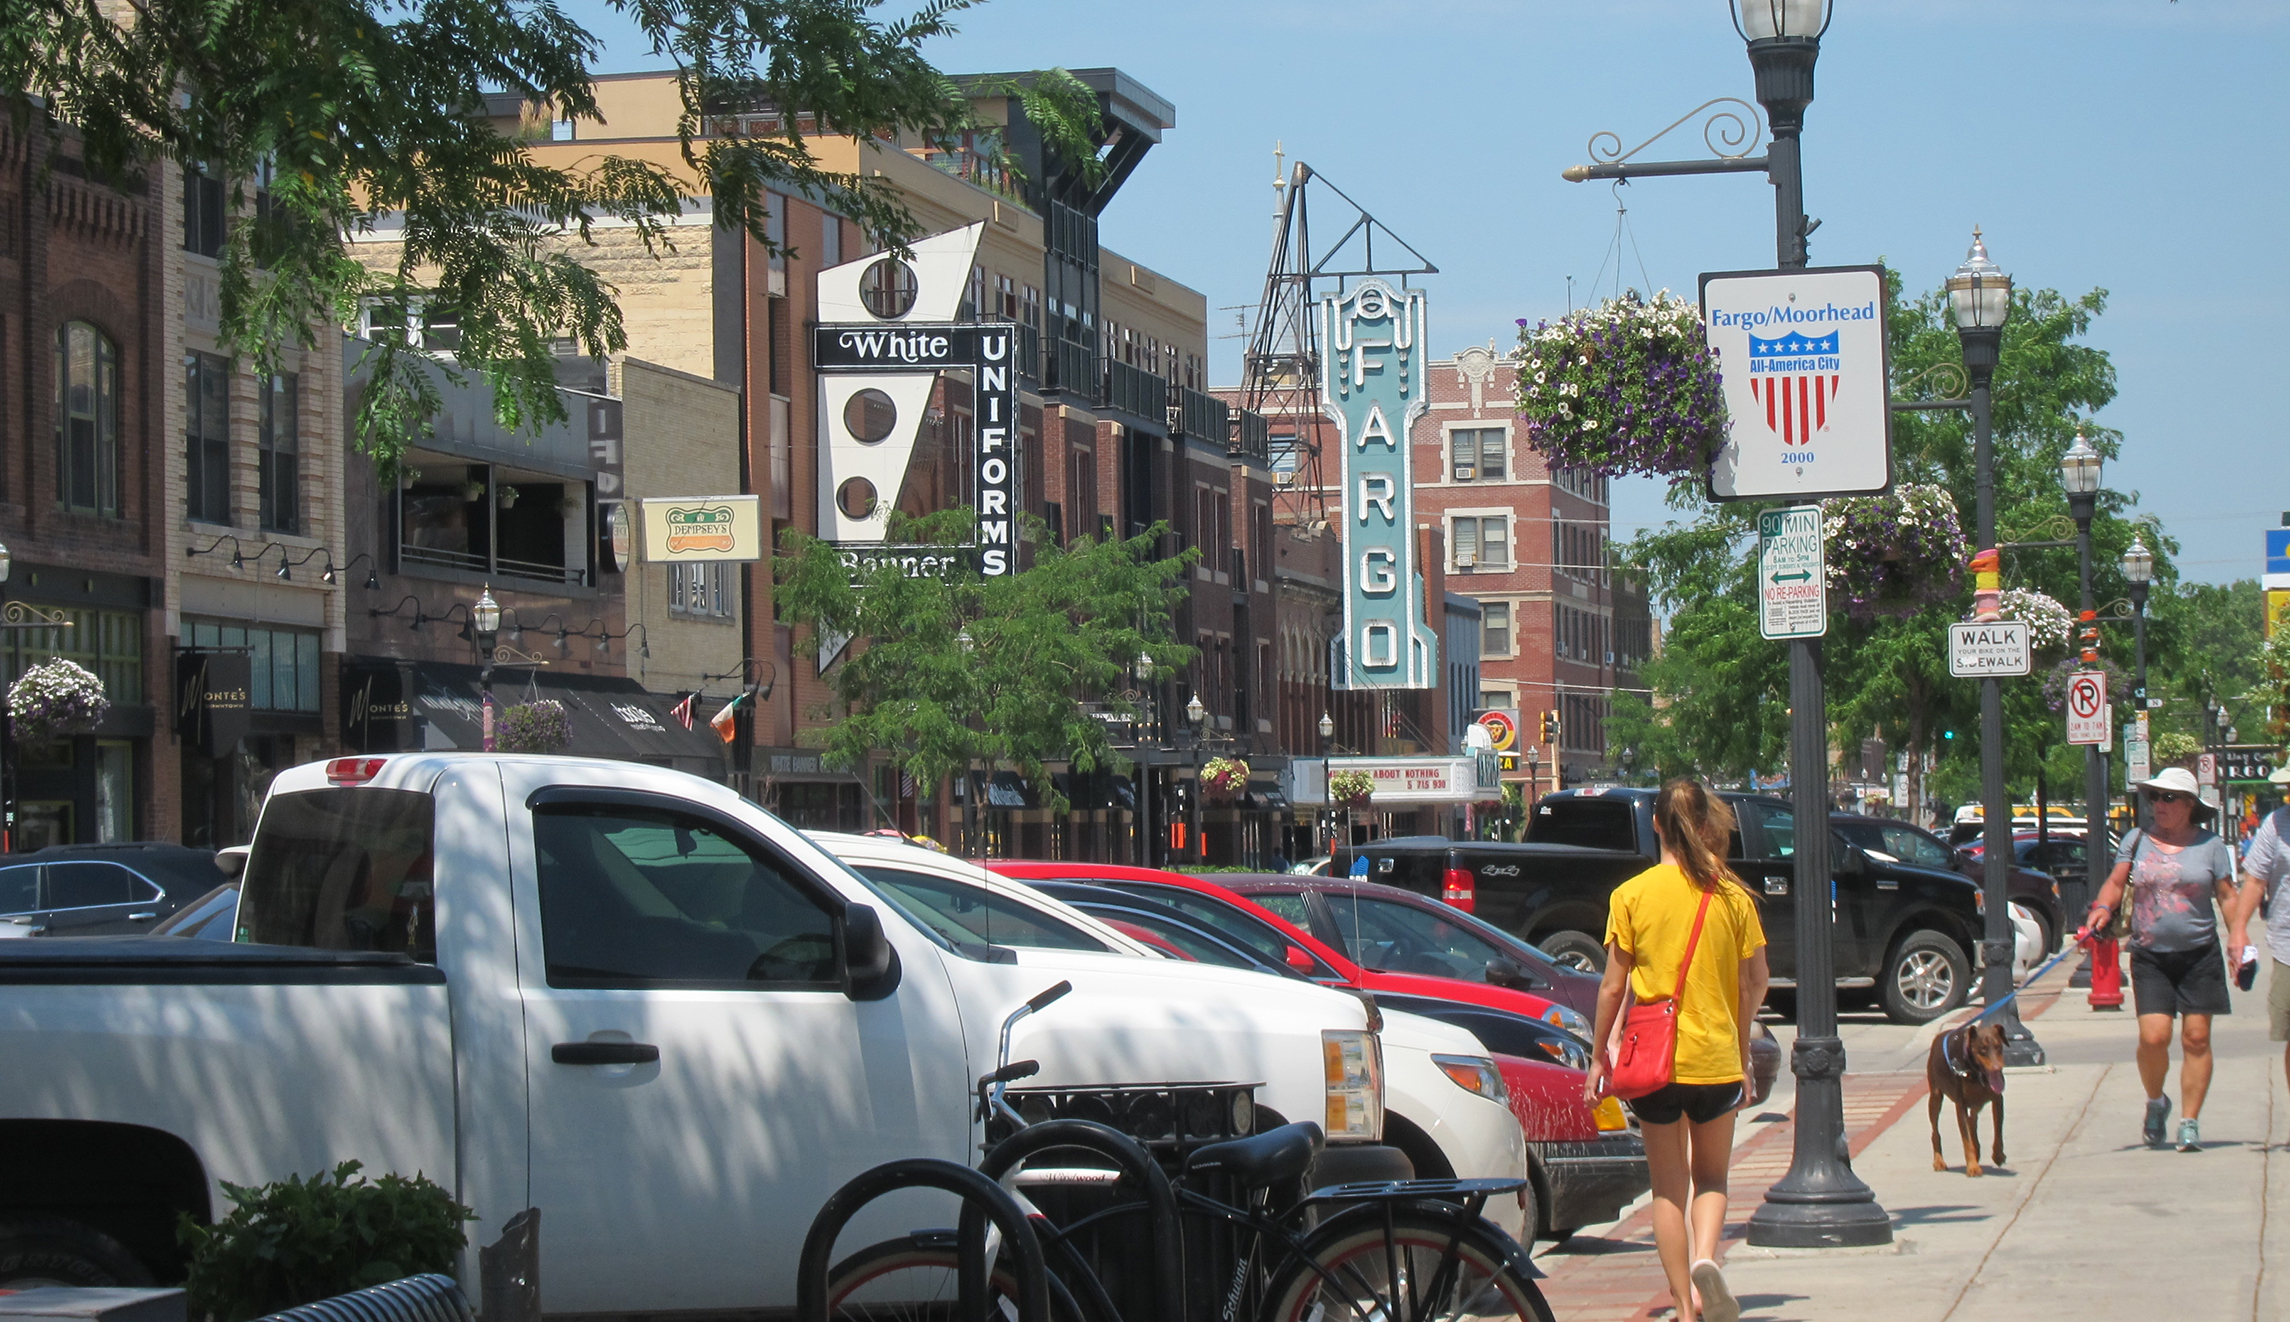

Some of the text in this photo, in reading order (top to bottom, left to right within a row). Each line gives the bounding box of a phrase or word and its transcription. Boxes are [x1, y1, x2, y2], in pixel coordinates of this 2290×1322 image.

[1711, 301, 1875, 331] Fargo/Moorhead
[839, 330, 949, 363] White
[1750, 357, 1840, 373] All-America City
[981, 335, 1008, 576] UNIFORMS
[1780, 452, 1815, 464] 2000
[1354, 338, 1398, 668] FARGO
[674, 524, 727, 535] DEMPSEY'S
[1762, 514, 1815, 534] 90 MIN
[1764, 535, 1818, 555] PARKING
[1773, 555, 1786, 563] 8AM
[1797, 553, 1810, 561] 5PM
[1765, 584, 1820, 600] NO RE-PARKING
[1961, 629, 2016, 645] WALK
[1956, 656, 2023, 668] SEWALK
[1373, 769, 1401, 779] ABOUT
[1405, 769, 1440, 779] NOTHING
[1433, 780, 1446, 789] 930
[1481, 864, 1521, 877] 4x4
[1223, 1257, 1248, 1322] Schwinn
